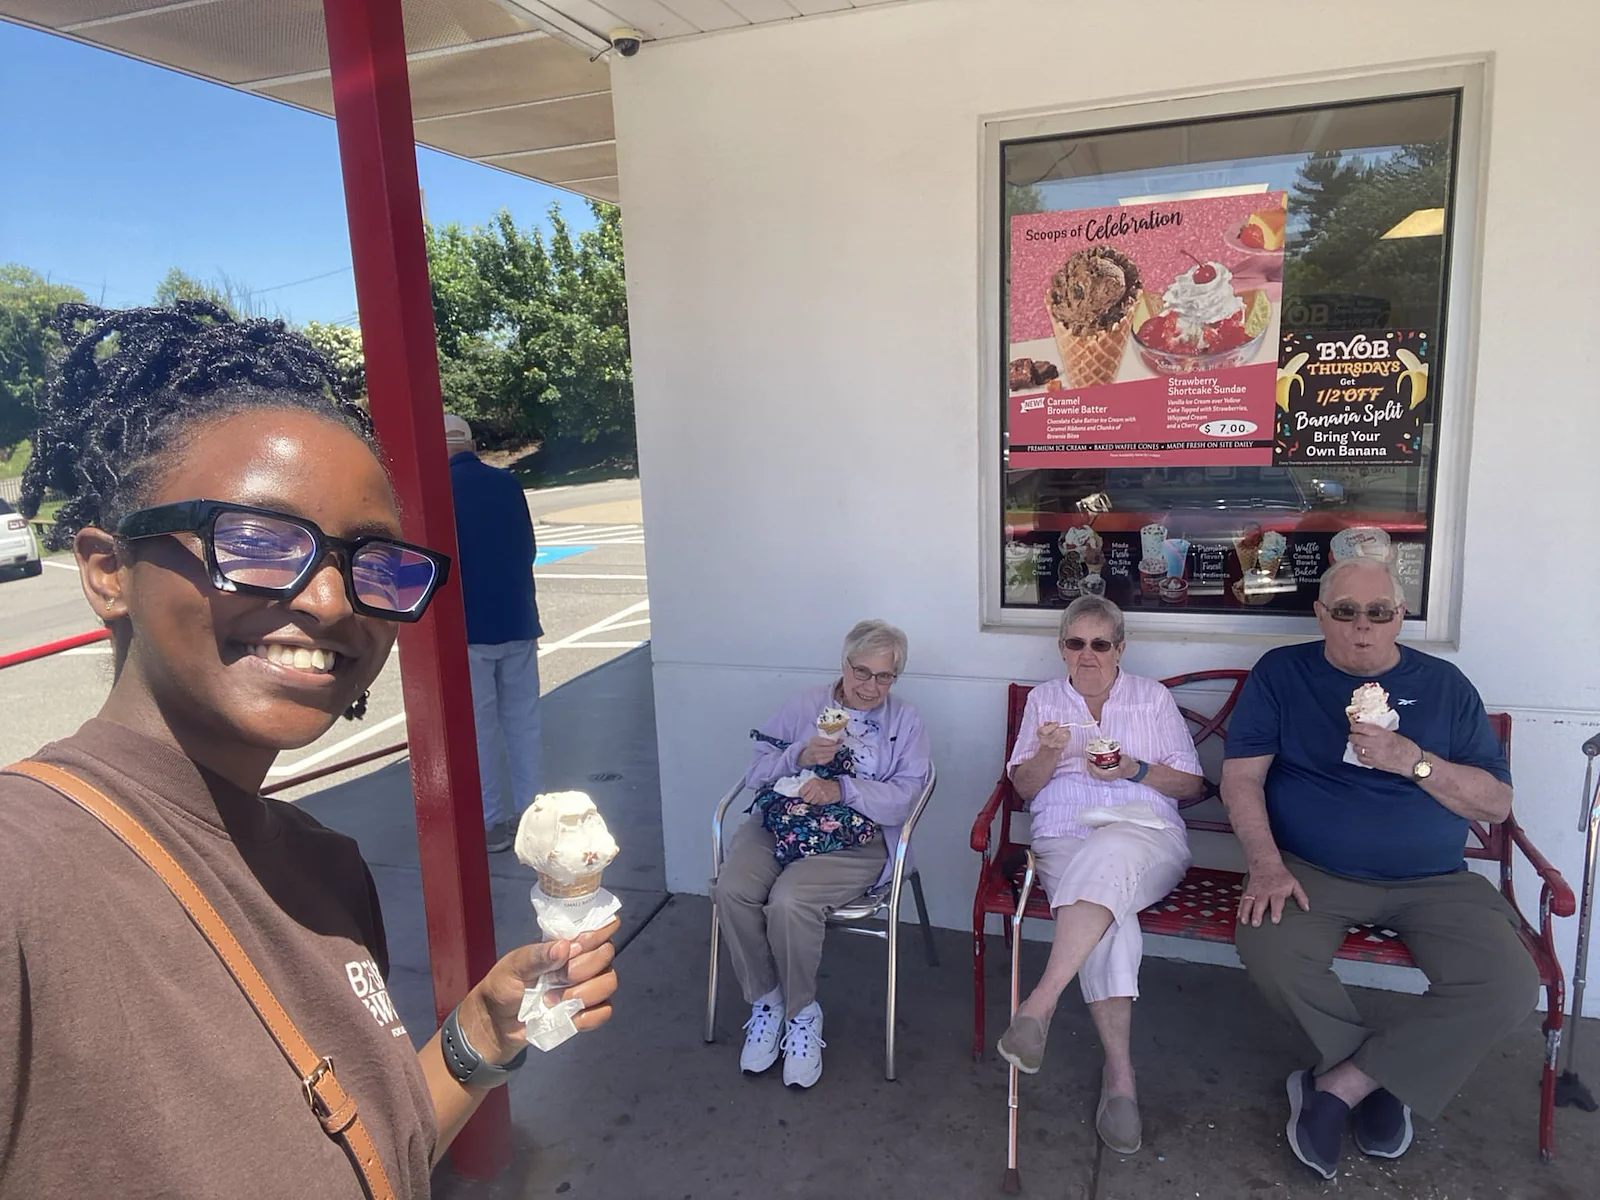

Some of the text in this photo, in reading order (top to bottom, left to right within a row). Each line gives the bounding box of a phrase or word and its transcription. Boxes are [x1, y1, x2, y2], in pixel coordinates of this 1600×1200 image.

[1026, 210, 1183, 243] Scoops of Celebration
[1307, 361, 1401, 377] THURSDAYS
[1168, 377, 1218, 387] Strawberry
[1340, 378, 1356, 386] Get
[1168, 385, 1247, 396] Shortcake Sundae
[1047, 396, 1080, 406] Caramel
[1317, 387, 1384, 406] 1/2 OFF
[1047, 405, 1108, 415] Brownie Batter
[1181, 406, 1200, 414] Topped
[1295, 400, 1404, 430] Banana Split
[1204, 424, 1246, 434] $ 7.00
[1314, 430, 1381, 444] Bring Your
[1306, 446, 1387, 457] Own Banana
[1294, 542, 1320, 554] Waffle
[1112, 549, 1130, 558] Fresh
[1111, 566, 1129, 576] Daily
[1294, 566, 1318, 576] Baked
